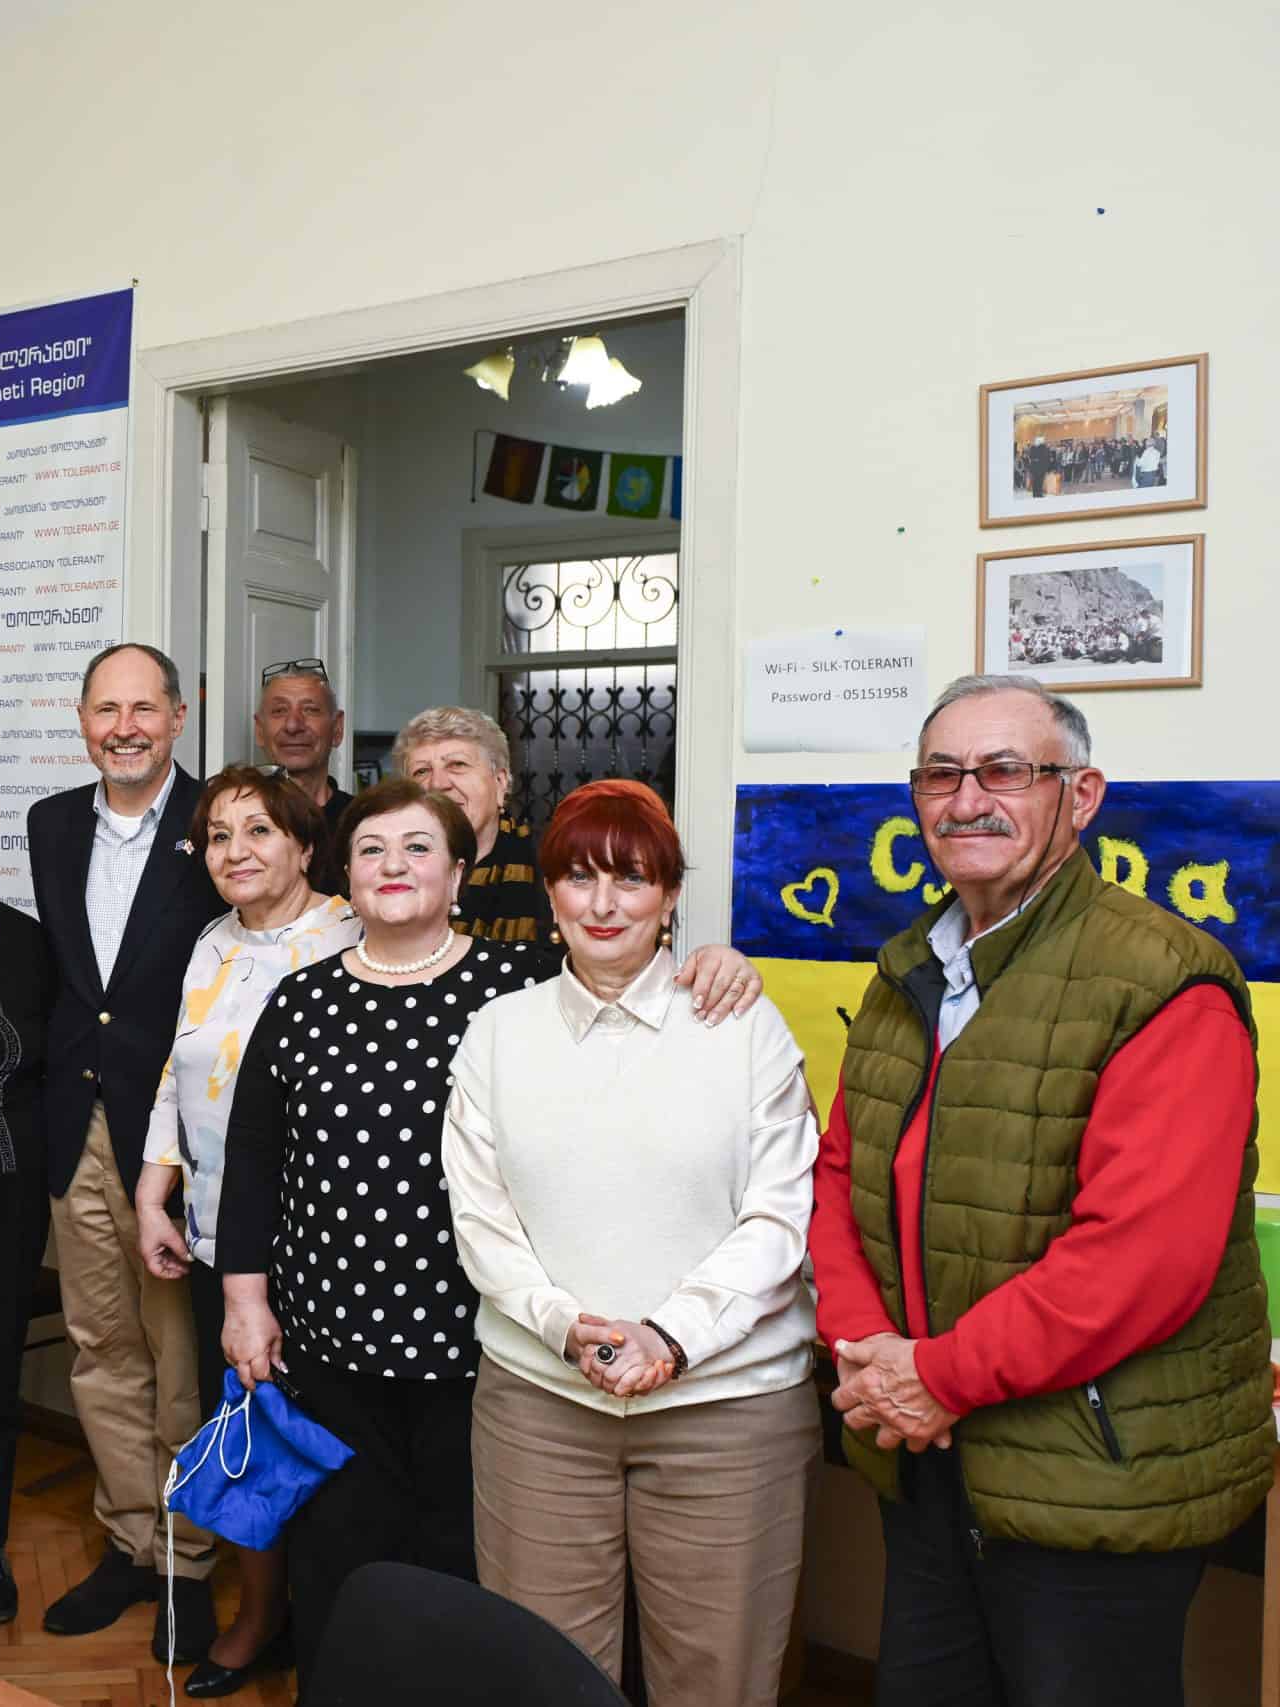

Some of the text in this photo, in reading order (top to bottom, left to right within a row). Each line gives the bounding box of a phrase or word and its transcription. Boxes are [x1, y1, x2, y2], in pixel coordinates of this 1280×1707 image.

[31, 373, 86, 398] Region
[765, 663, 797, 674] Wi-Fi
[812, 657, 913, 673] SILK-TOLERANTI
[771, 690, 832, 703] Password
[844, 687, 908, 700] 05151958
